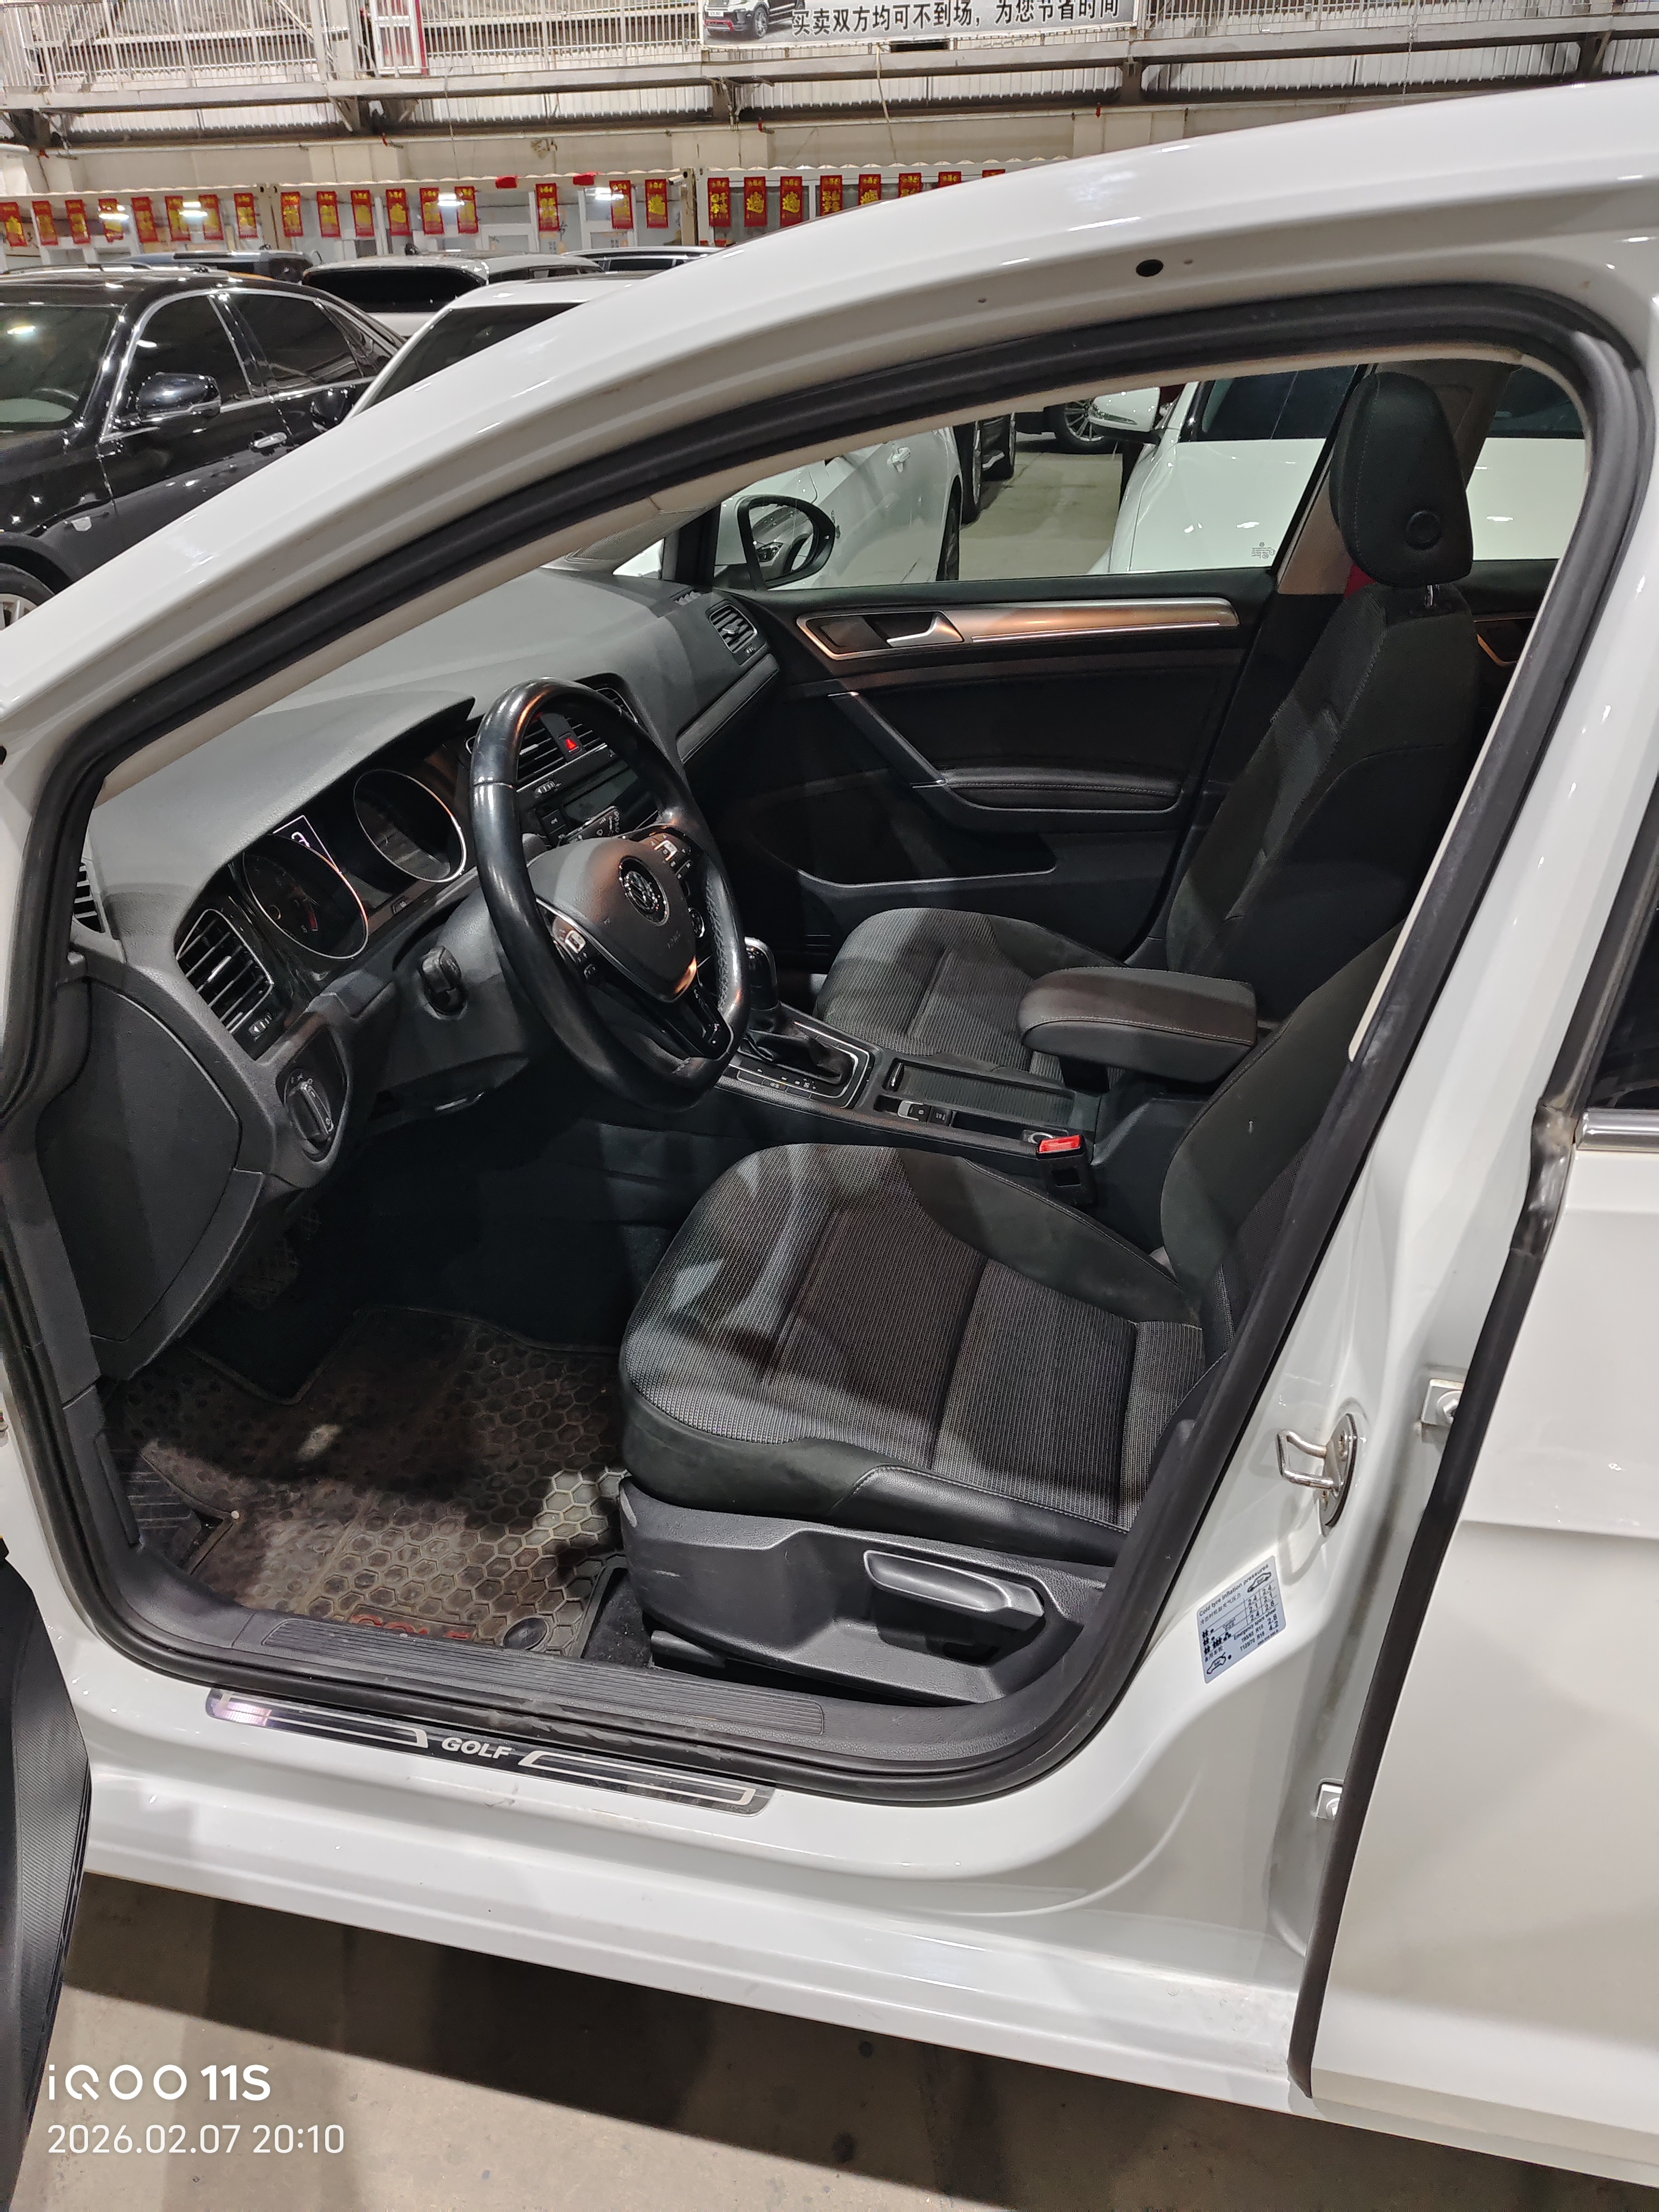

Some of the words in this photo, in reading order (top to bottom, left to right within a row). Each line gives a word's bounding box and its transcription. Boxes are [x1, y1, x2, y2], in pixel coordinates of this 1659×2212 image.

[792, 0, 1119, 36] 买卖双方均可不到场，为您节省时间
[1199, 1604, 1210, 1616] Cold
[1211, 1599, 1221, 1608] tyre
[1222, 1583, 1242, 1600] inflation
[1243, 1564, 1269, 1586] pressures
[1263, 1584, 1272, 1595] 2.4
[1249, 1603, 1258, 1613] 2.1
[1264, 1593, 1272, 1603] 2.1
[1250, 1610, 1259, 1622] 2.4
[1265, 1600, 1274, 1611] 2.8
[1234, 1624, 1253, 1641] Emergency
[1255, 1616, 1264, 1626] spare
[1265, 1607, 1276, 1617] wheel
[1267, 1614, 1277, 1625] 2.8
[1240, 1638, 1255, 1651] T125/70
[1269, 1621, 1278, 1630] 4.2
[442, 1737, 512, 1759] GOLF
